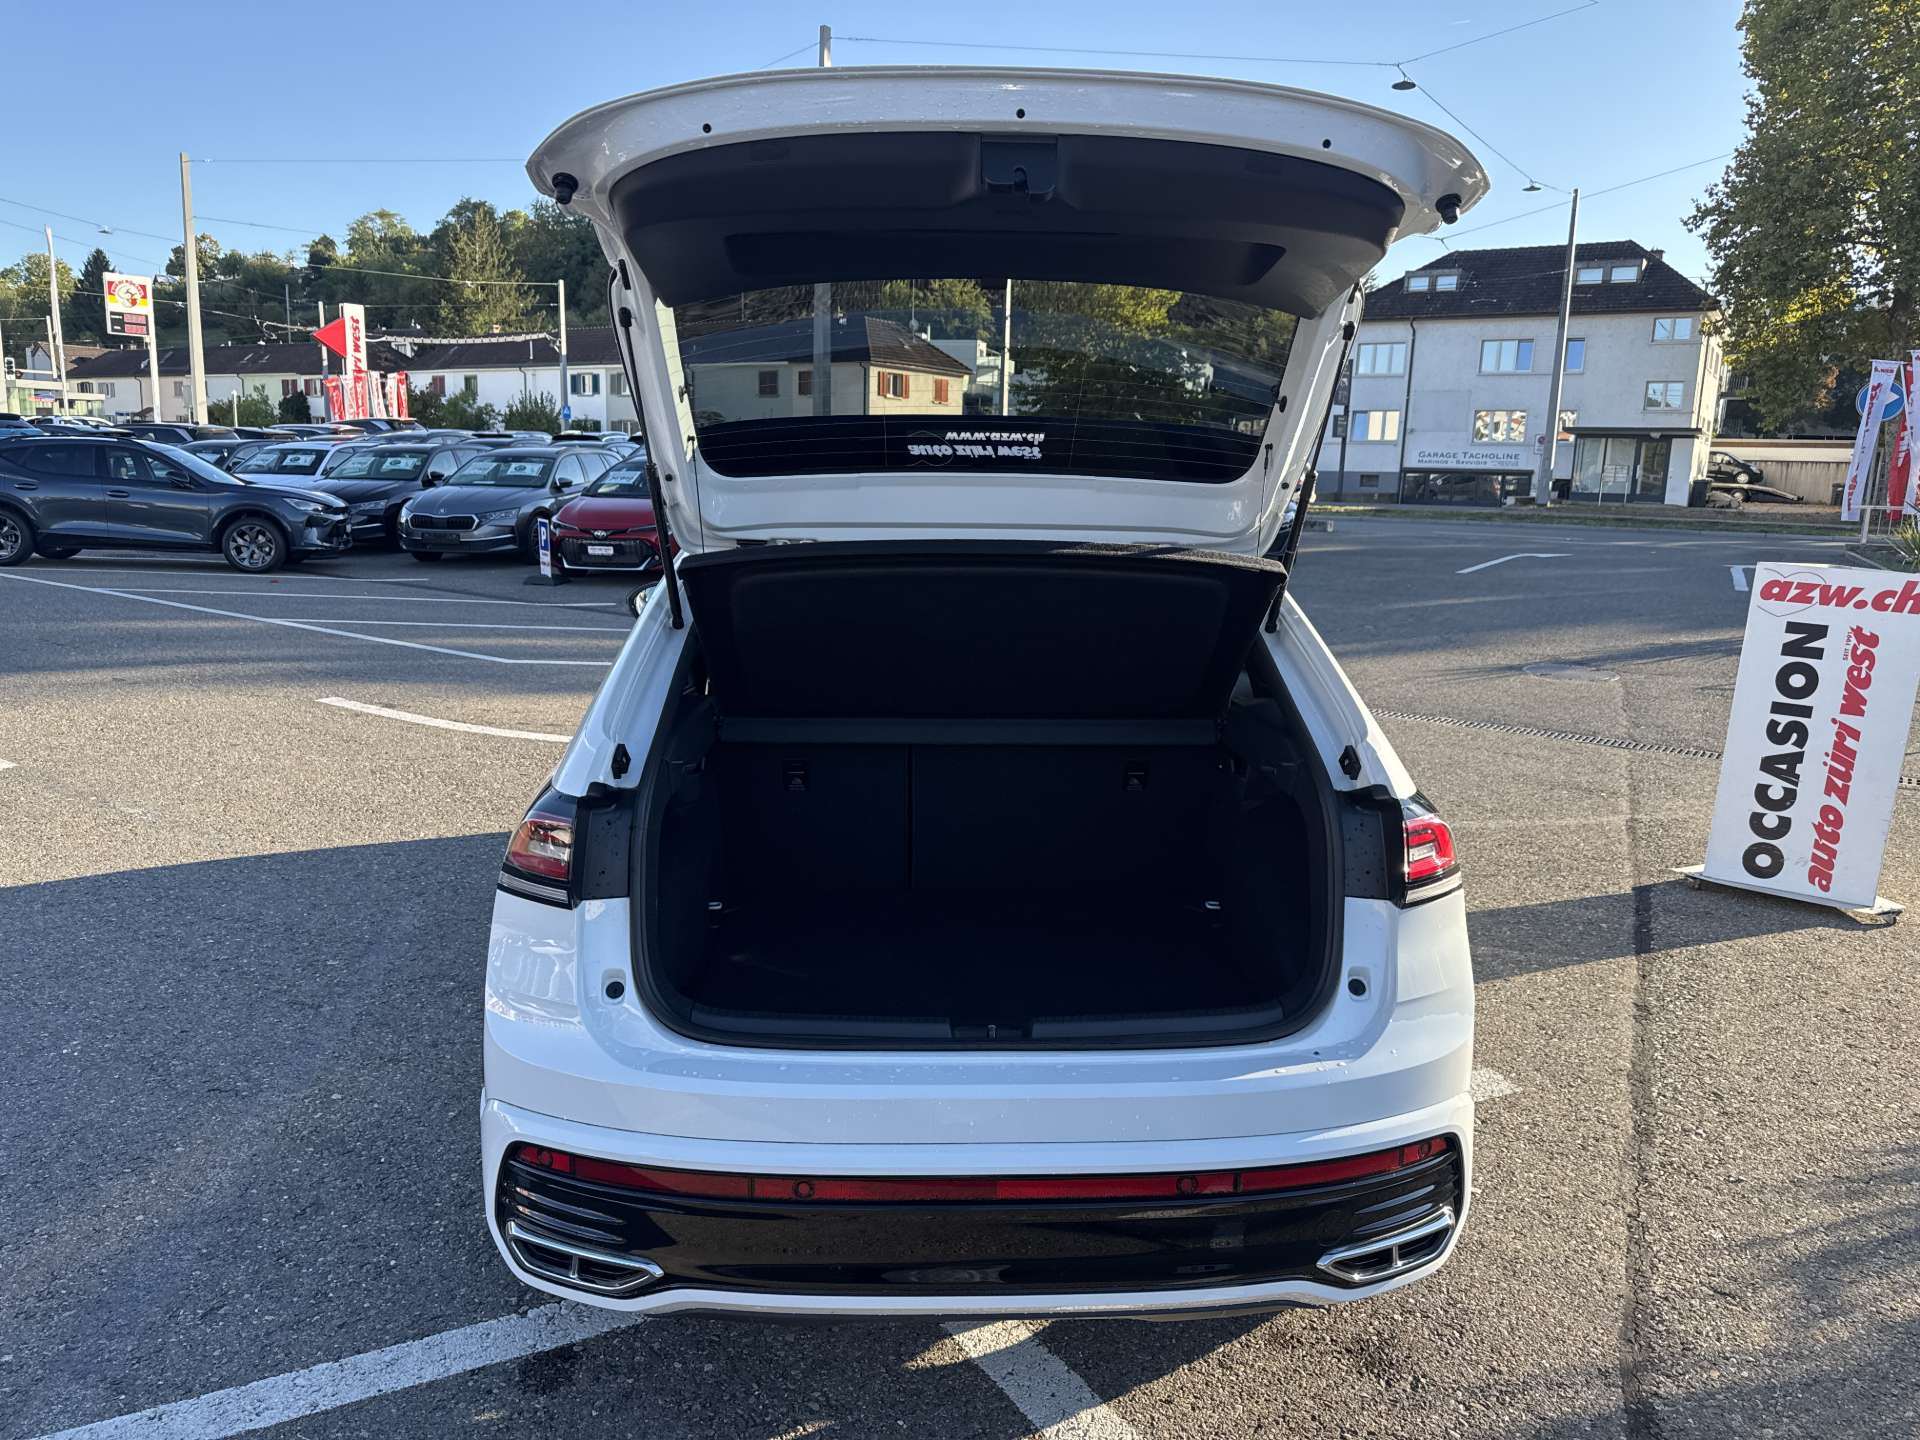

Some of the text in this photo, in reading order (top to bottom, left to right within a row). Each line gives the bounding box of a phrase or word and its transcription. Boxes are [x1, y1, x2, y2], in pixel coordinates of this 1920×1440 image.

[350, 315, 361, 353] west
[1462, 452, 1521, 460] TACHOLINE
[541, 527, 546, 546] P
[1760, 578, 1920, 615] azw.ch
[1742, 620, 1829, 879] OCCASION
[1808, 625, 1880, 893] auto züri west
